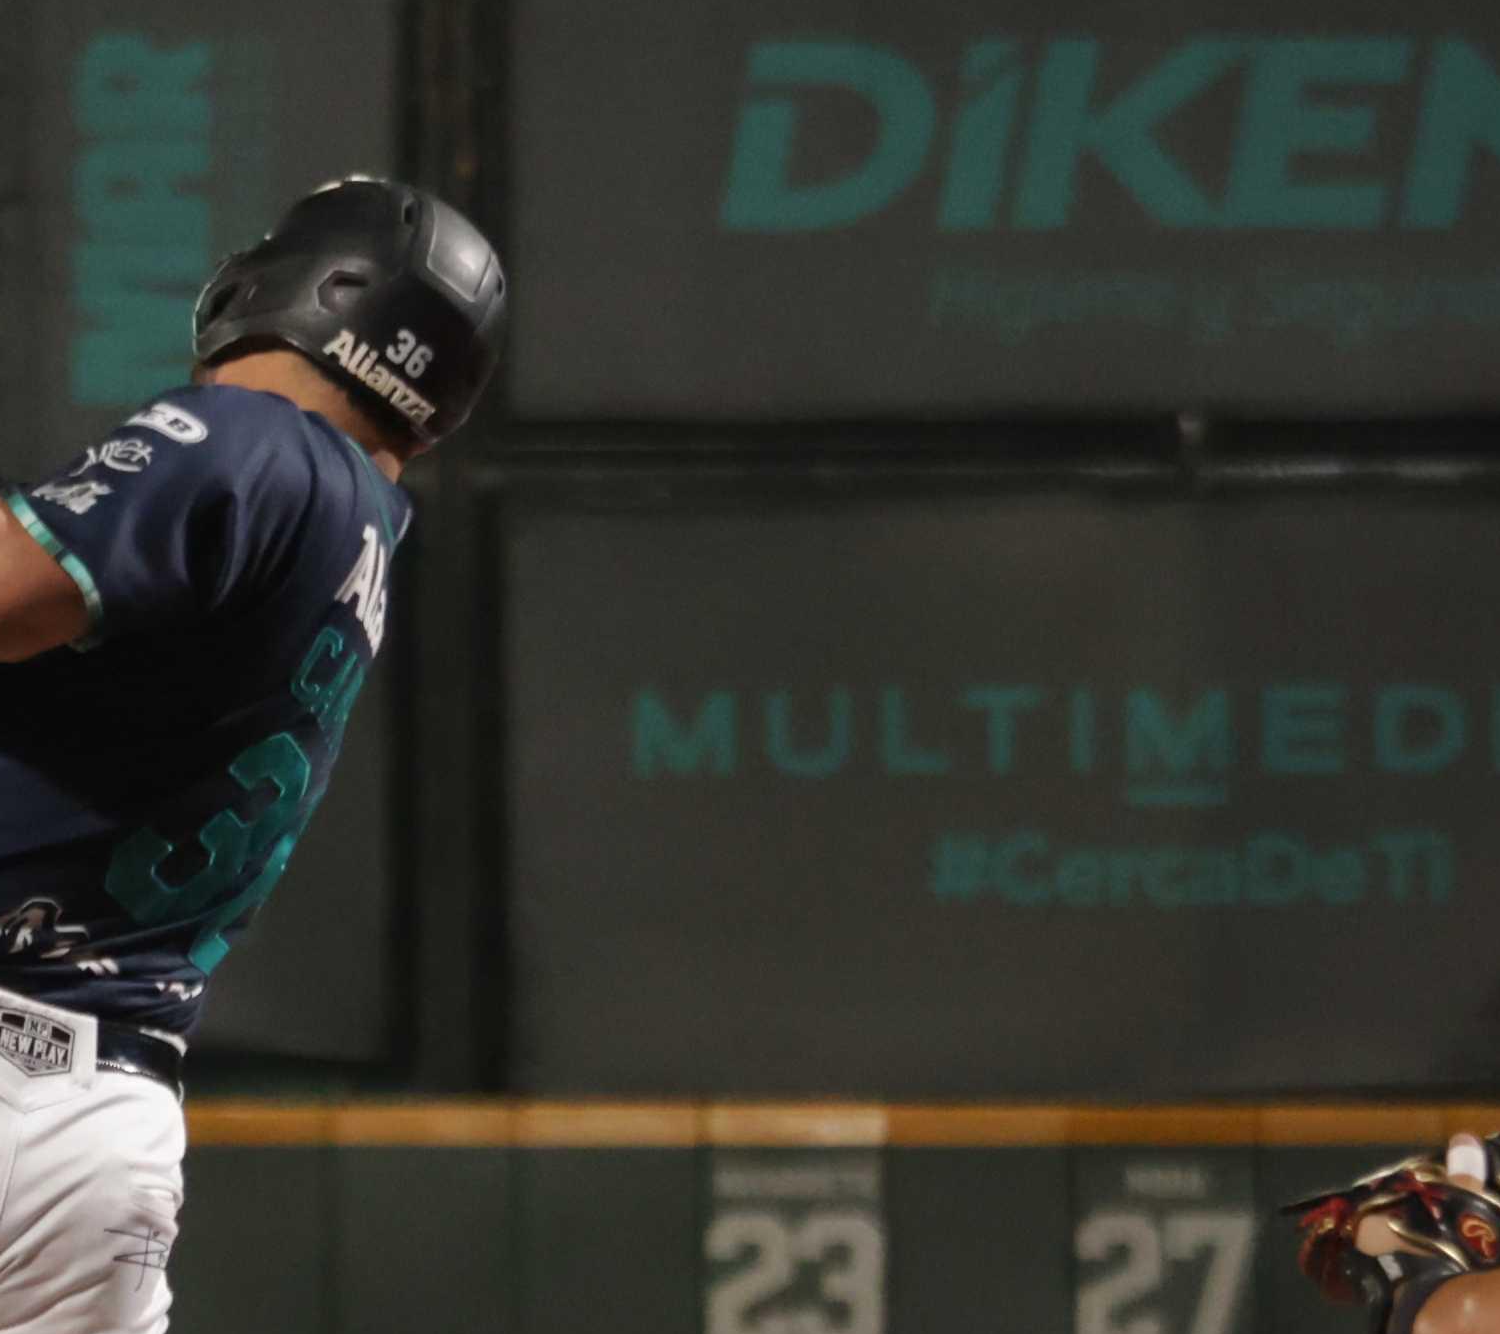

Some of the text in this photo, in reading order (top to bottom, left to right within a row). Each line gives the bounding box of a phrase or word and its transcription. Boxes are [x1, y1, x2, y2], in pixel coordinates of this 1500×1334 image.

[385, 328, 434, 380] 36
[0, 1026, 68, 1067] NEW PLAY
